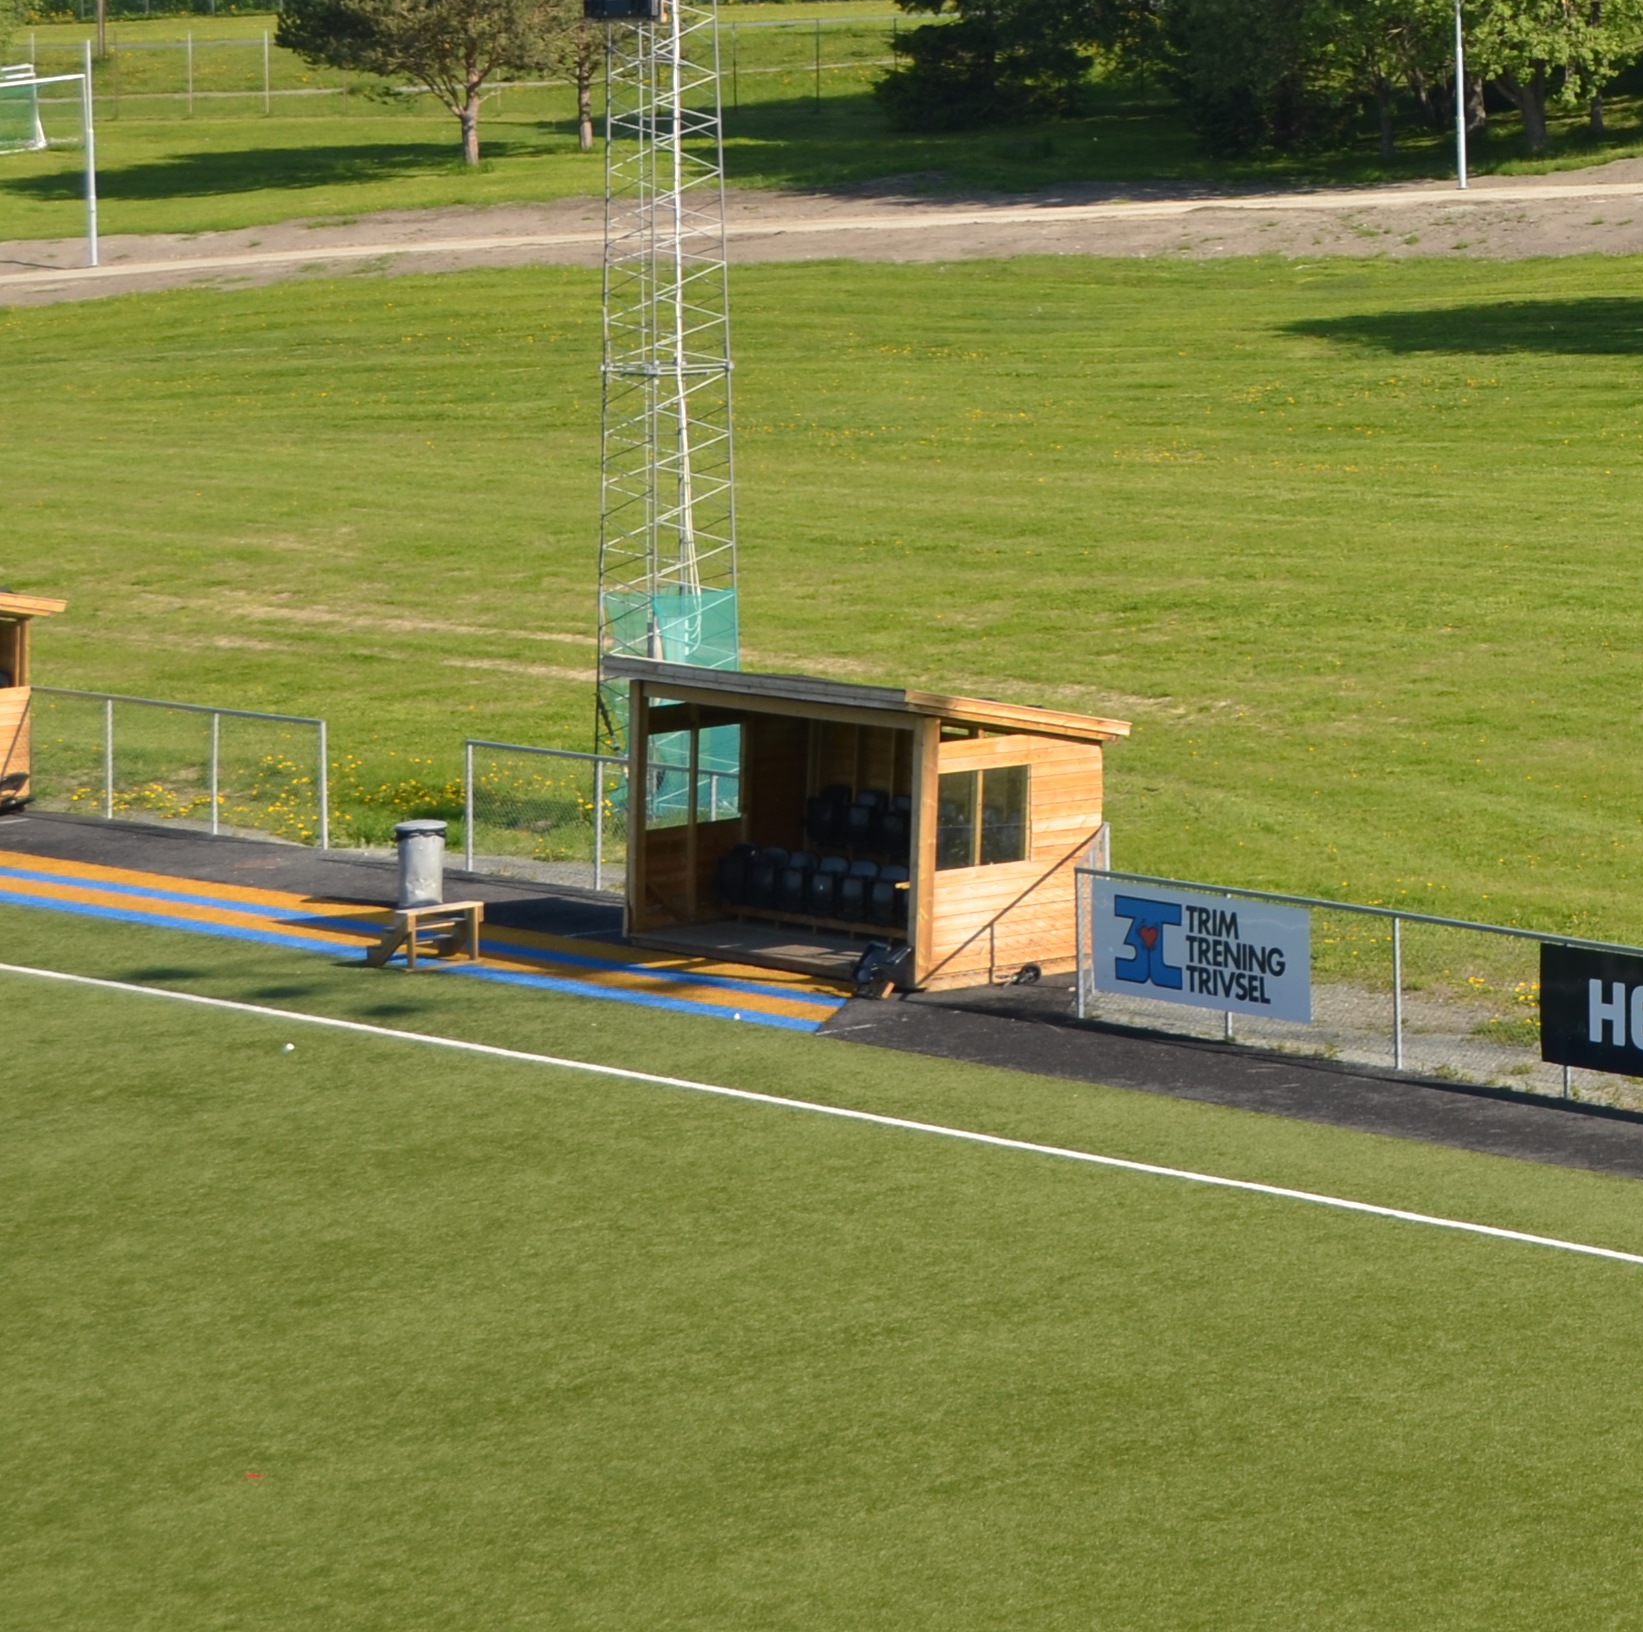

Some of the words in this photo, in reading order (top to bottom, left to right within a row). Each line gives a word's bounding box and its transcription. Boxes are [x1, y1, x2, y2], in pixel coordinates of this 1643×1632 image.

[1185, 905, 1239, 940] TRIM
[1185, 935, 1286, 977] TRENING
[1185, 965, 1271, 1005] TRIVSEL
